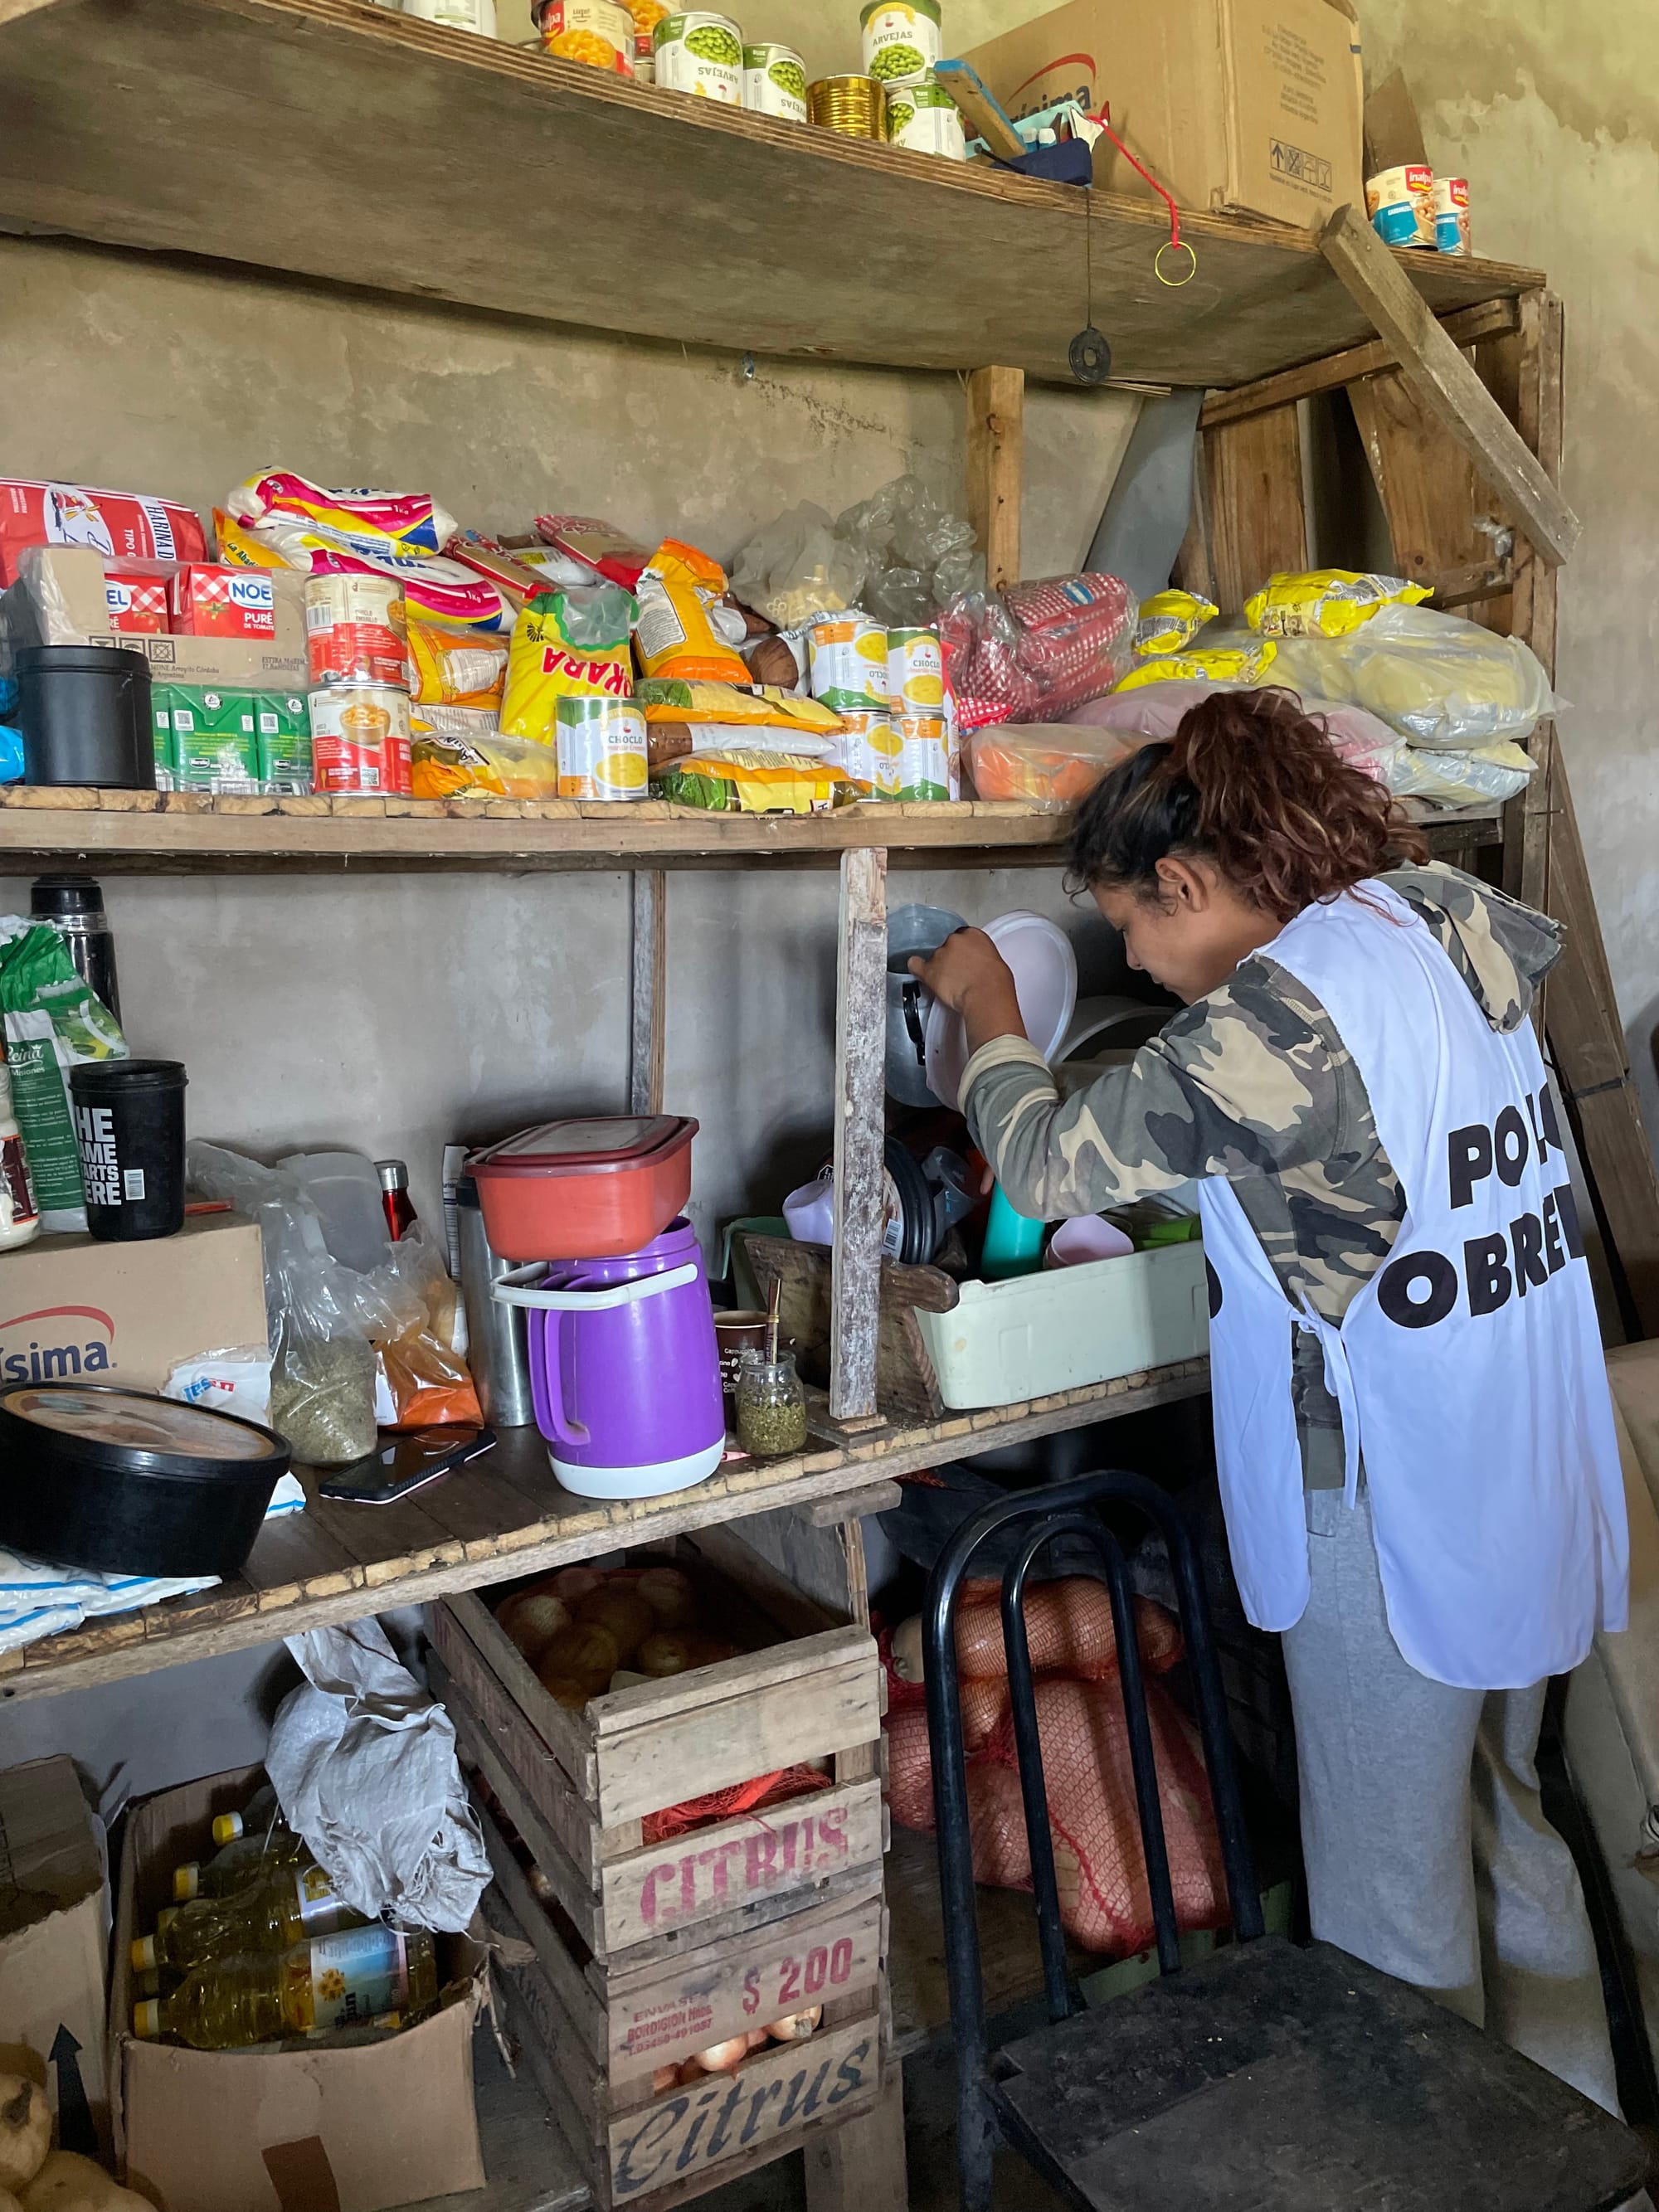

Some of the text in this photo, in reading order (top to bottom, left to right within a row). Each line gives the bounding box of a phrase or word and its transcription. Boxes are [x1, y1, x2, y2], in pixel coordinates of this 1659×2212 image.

[872, 31, 913, 47] ARVEJAS
[698, 66, 738, 84] ARVEJAS
[780, 98, 806, 115] VEJAS
[145, 504, 173, 552] HARINA
[124, 528, 136, 550] TIPO
[106, 590, 129, 606] EL
[232, 582, 273, 601] NOE
[109, 616, 120, 630] RÉ
[244, 611, 274, 625] PURÉ
[608, 735, 643, 745] CHOCLO
[75, 1105, 115, 1143] HE
[80, 1141, 118, 1165] AME
[81, 1163, 119, 1182] ARTS
[84, 1179, 122, 1206] ERE
[0, 1341, 109, 1383] sima
[640, 1806, 849, 1929] CITRUS
[777, 1936, 854, 2006] 200
[614, 2039, 871, 2195] Citrus
